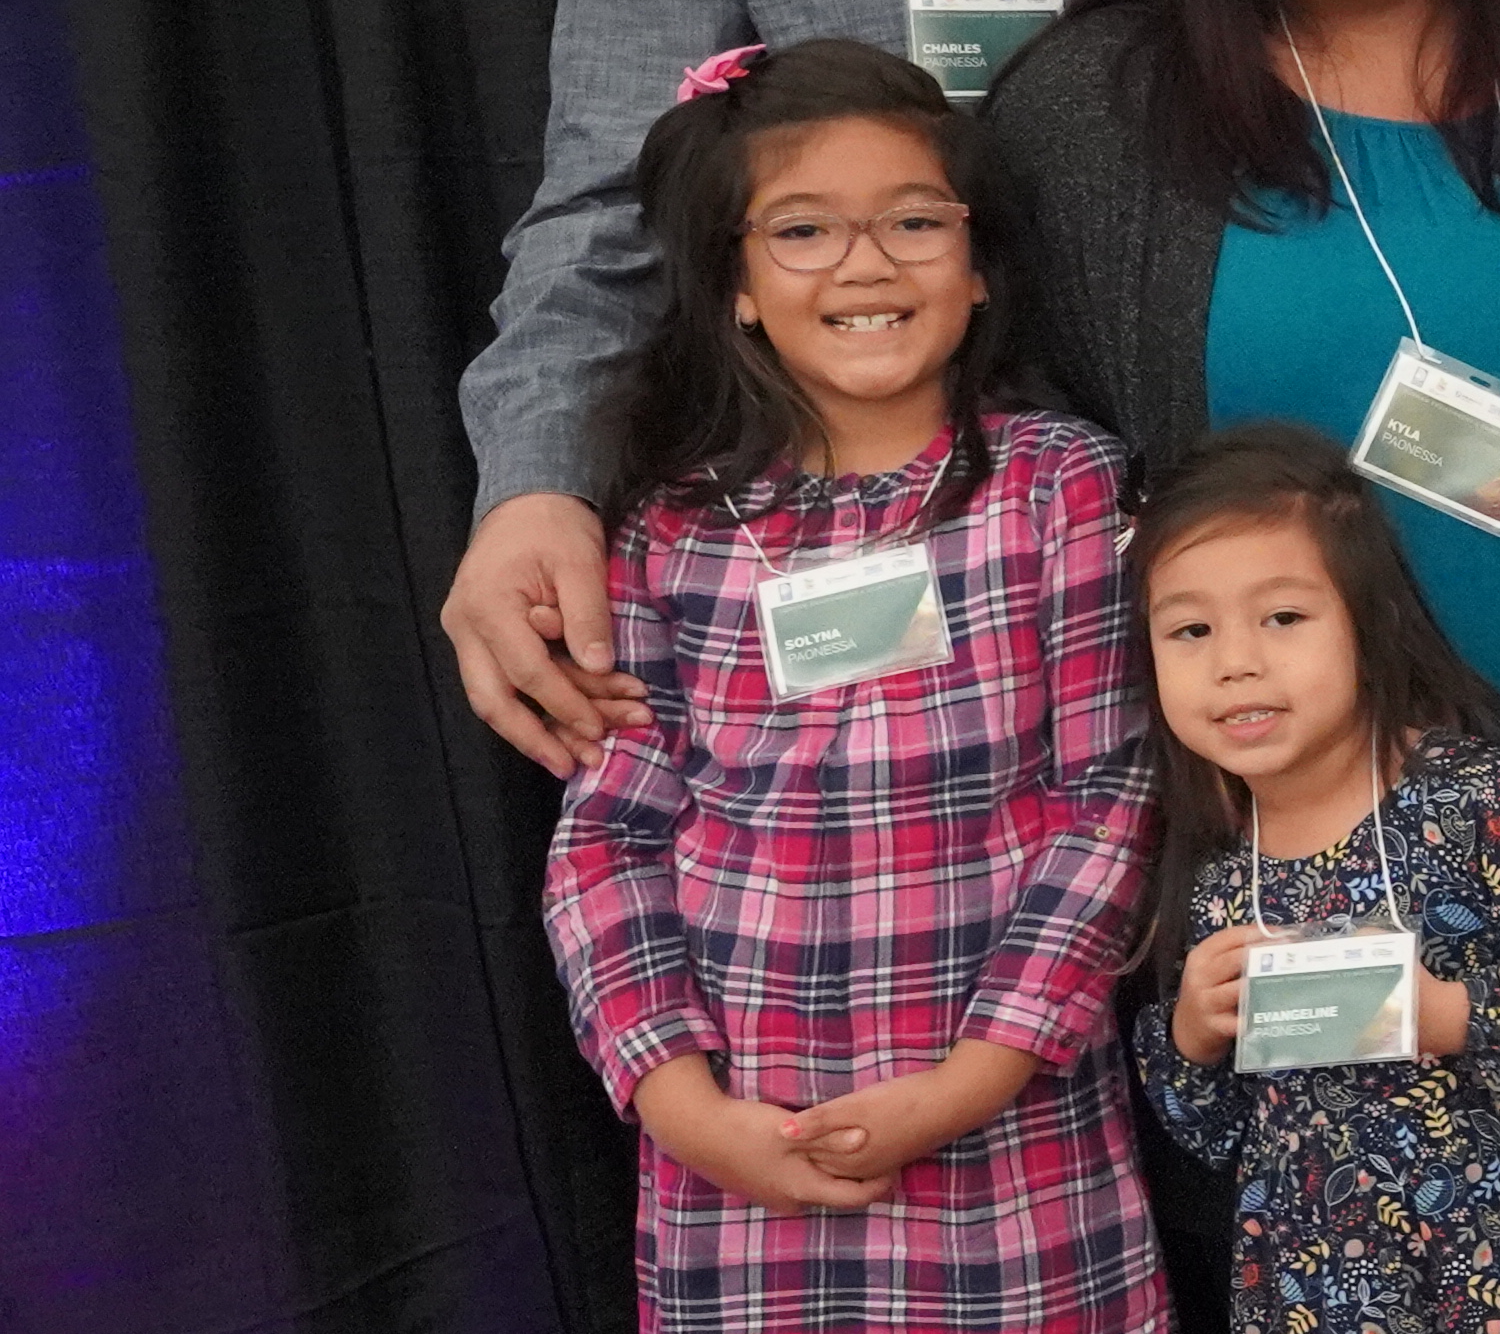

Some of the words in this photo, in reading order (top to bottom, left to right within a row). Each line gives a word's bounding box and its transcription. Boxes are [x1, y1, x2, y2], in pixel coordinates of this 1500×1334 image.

[922, 43, 982, 54] CHARLES
[923, 57, 988, 68] PAONESSA
[1386, 417, 1421, 442] KYLA
[1381, 431, 1444, 468] PAONESSA
[784, 628, 842, 651] SOLYNA
[787, 637, 857, 665] PAONESSA
[1253, 1005, 1339, 1024] EVANGELINE
[1254, 1022, 1322, 1038] PAONESSA
